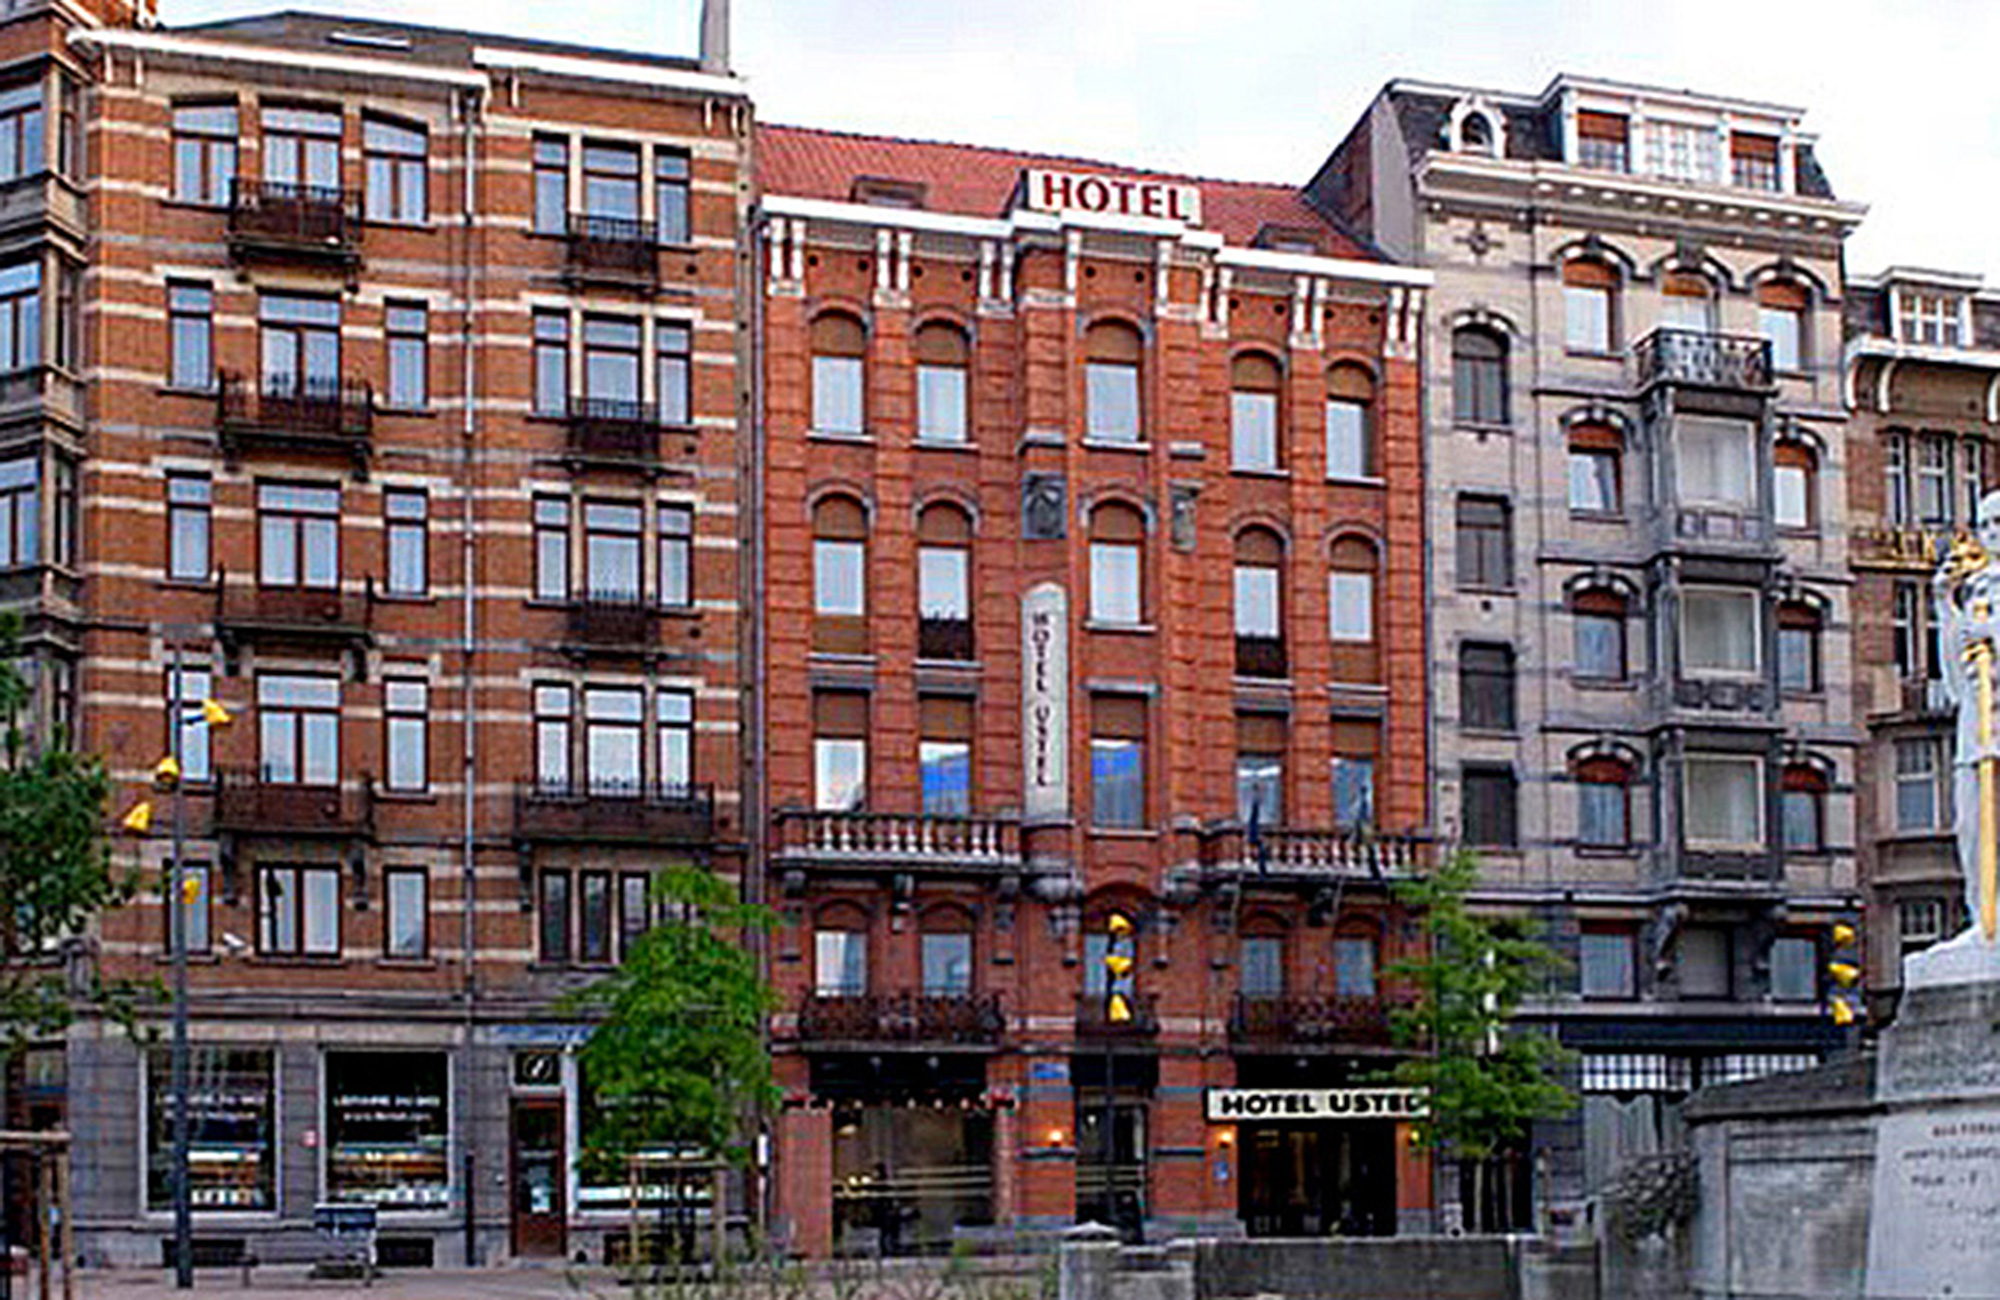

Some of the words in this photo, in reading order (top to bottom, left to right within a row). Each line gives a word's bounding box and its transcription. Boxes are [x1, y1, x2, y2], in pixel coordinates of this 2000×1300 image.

[1043, 173, 1190, 221] HOTEL
[1033, 613, 1050, 692] HOTEL
[1221, 1094, 1318, 1114] HOTEL
